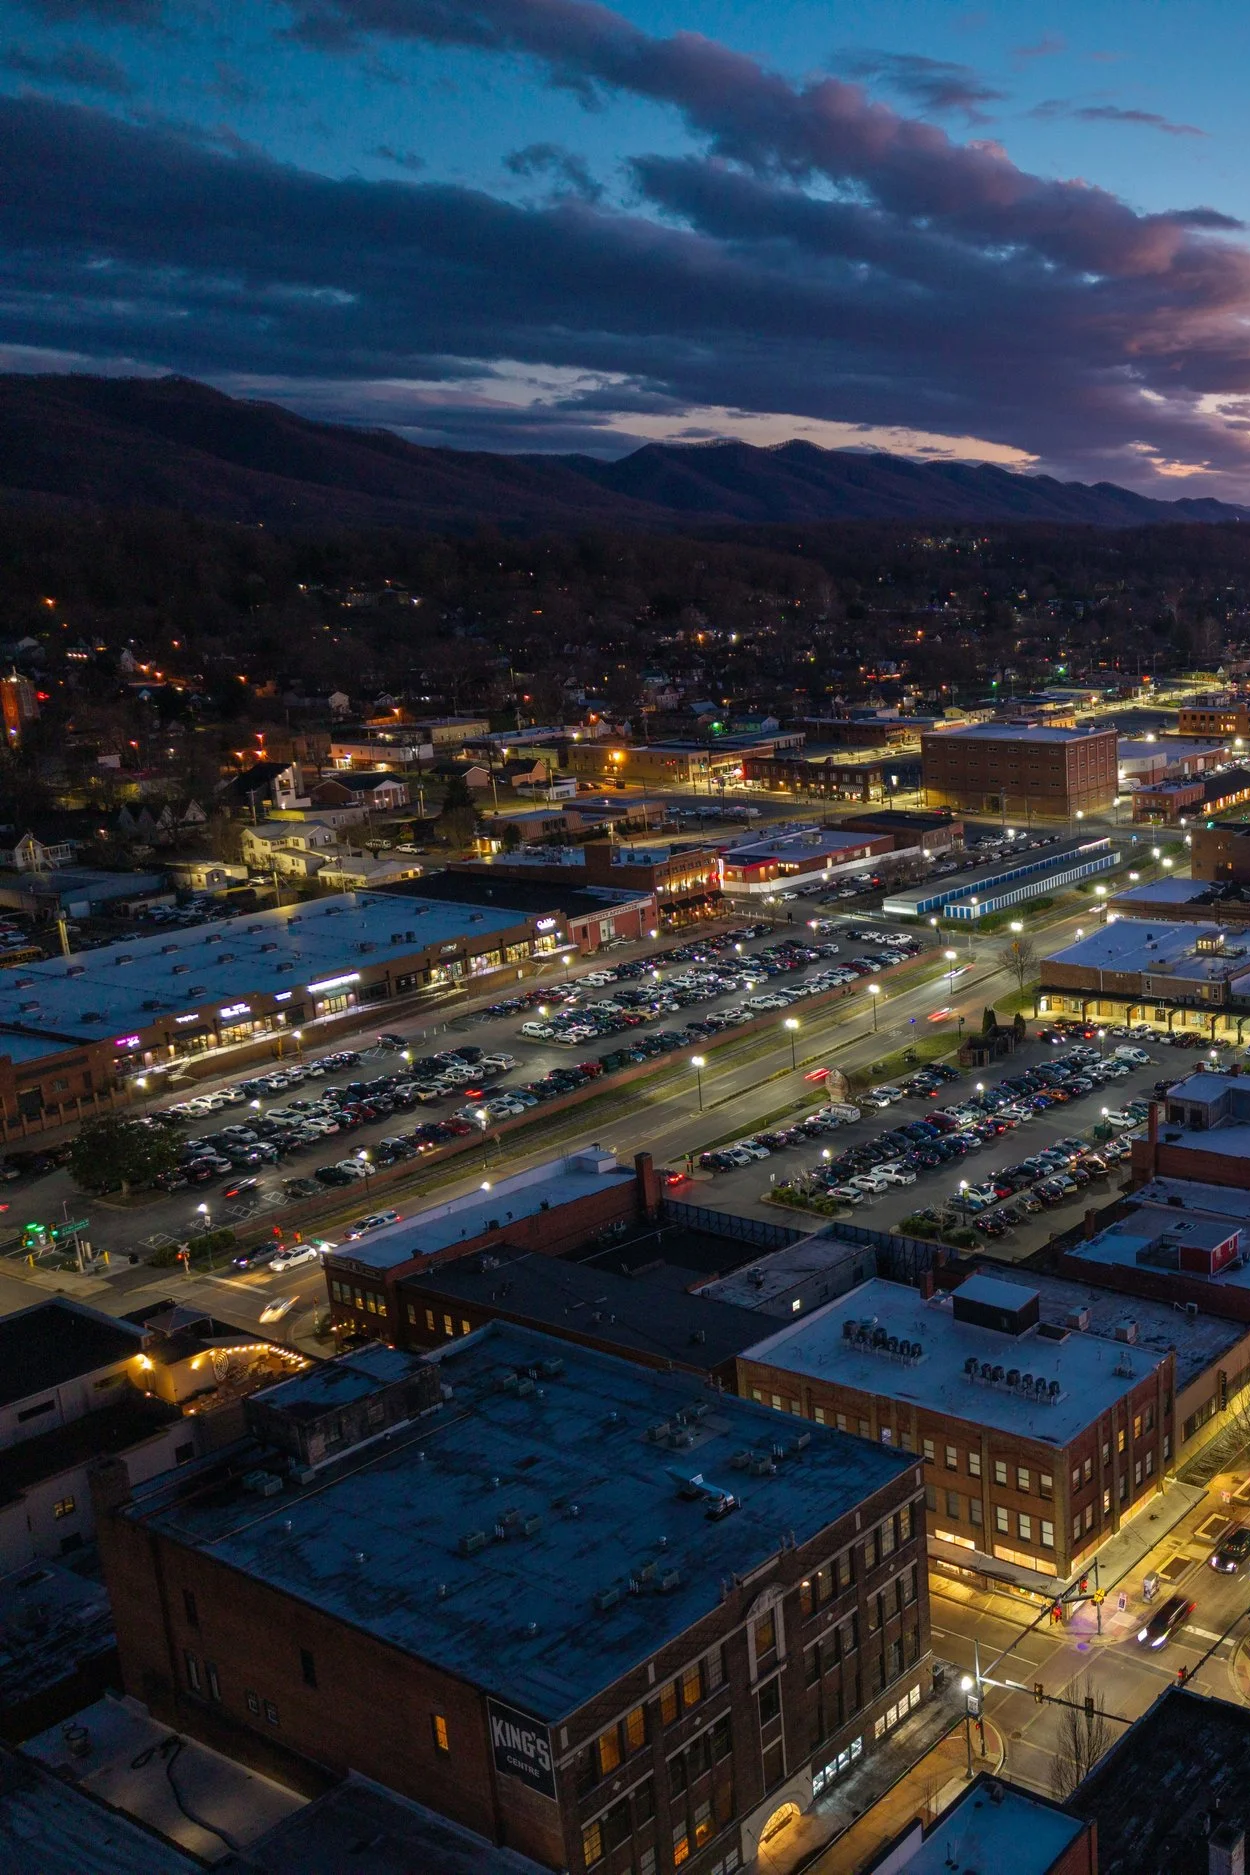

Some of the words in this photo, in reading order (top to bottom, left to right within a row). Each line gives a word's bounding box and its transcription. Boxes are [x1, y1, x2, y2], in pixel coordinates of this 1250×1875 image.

[610, 905, 638, 915] APPLIANCE
[492, 1716, 551, 1771] KING'S
[507, 1755, 540, 1778] CENTRE
